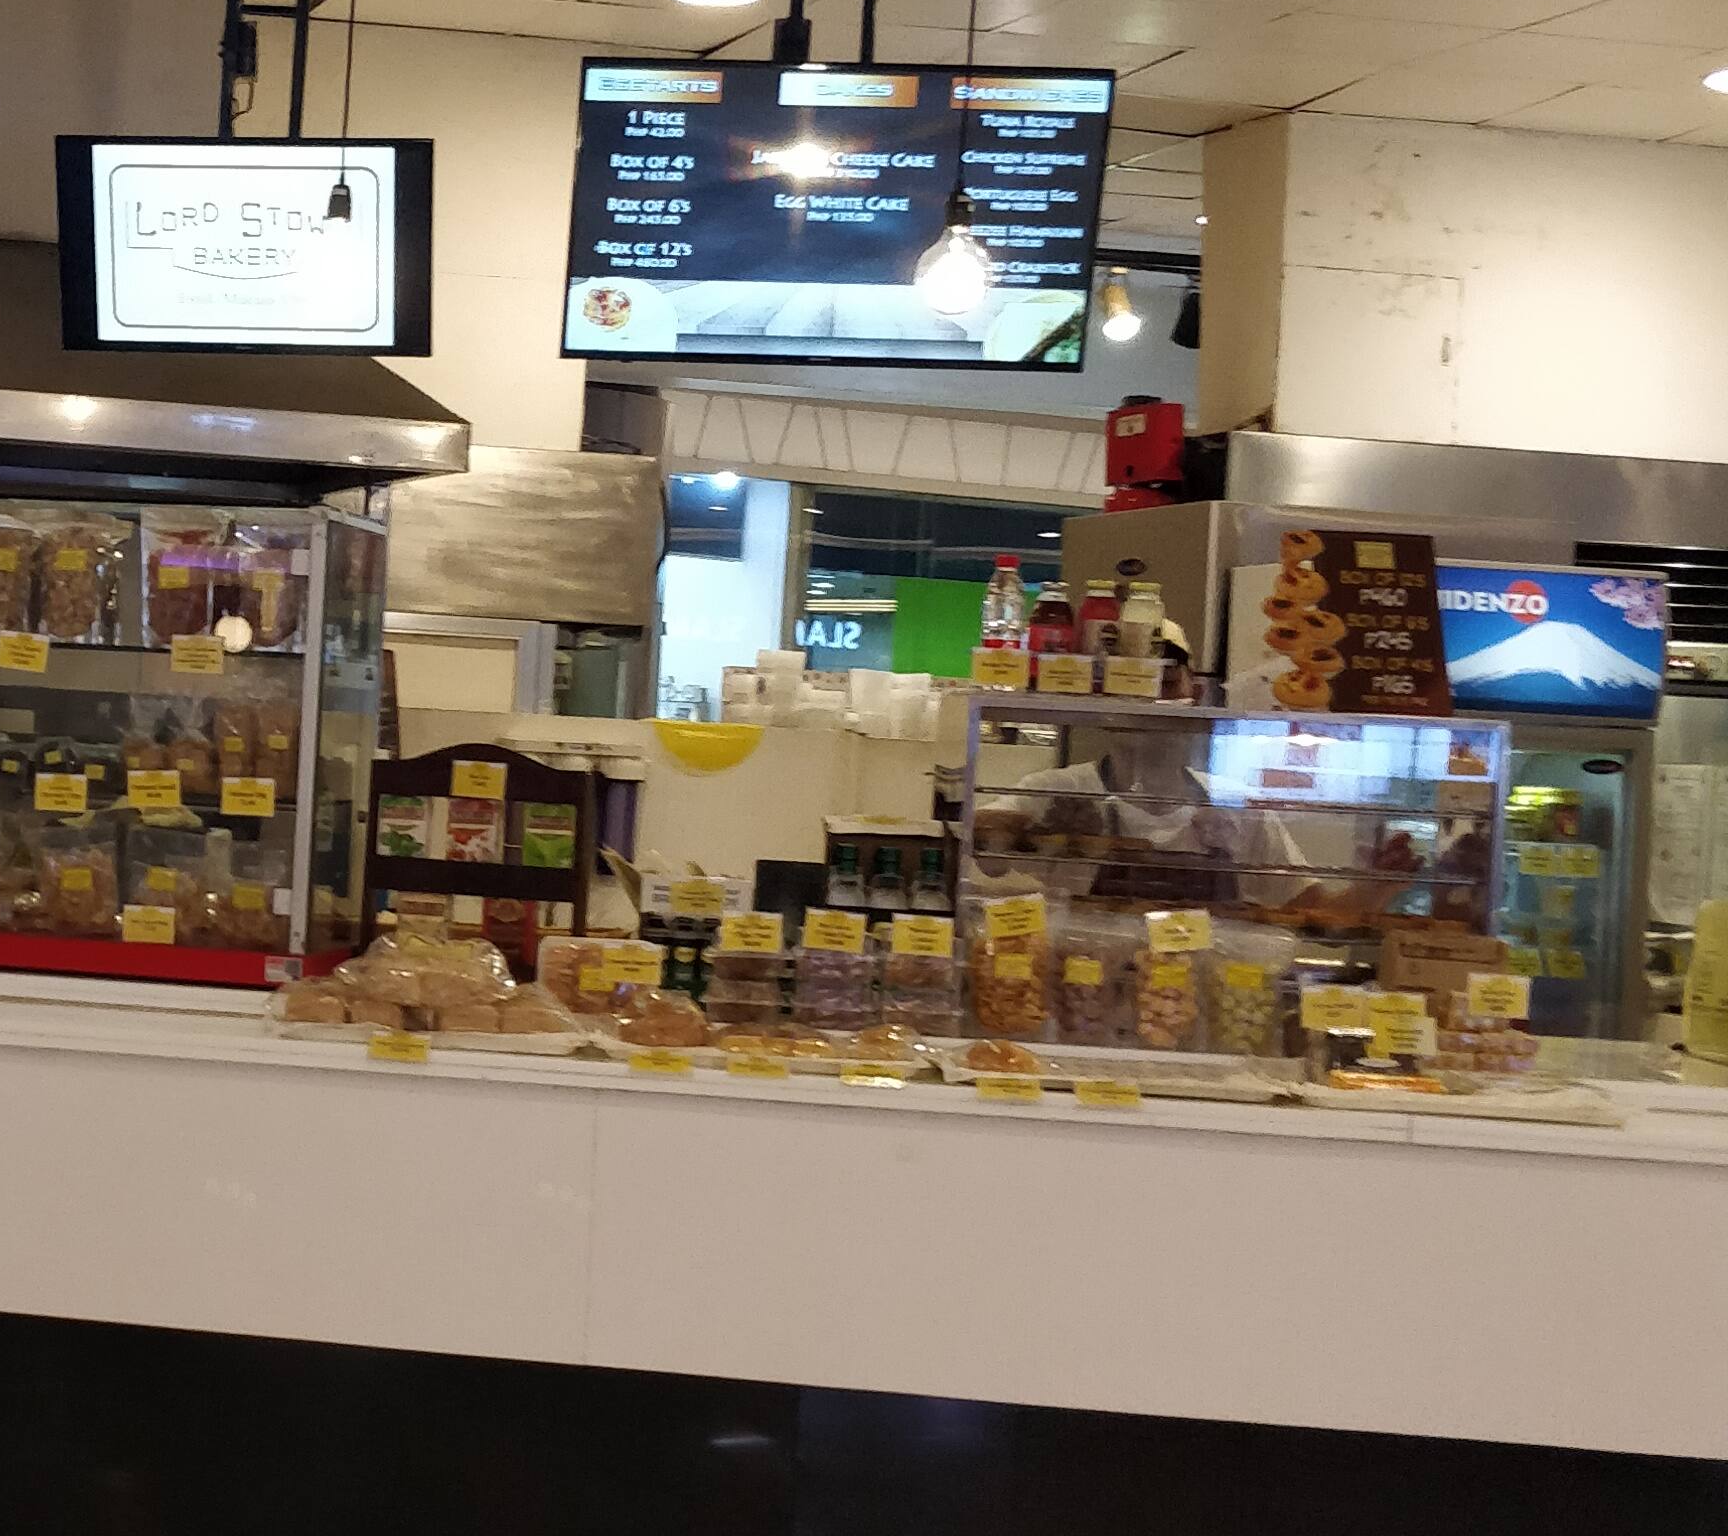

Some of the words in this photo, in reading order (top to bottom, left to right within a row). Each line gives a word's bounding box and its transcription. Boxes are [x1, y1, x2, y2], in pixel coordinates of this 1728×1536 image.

[642, 110, 685, 125] PIECE
[610, 153, 644, 168] BOX
[646, 155, 669, 168] OF
[829, 152, 890, 166] CHEESE
[891, 152, 937, 168] CAKE
[606, 197, 641, 212] BOX
[642, 199, 666, 212] OF
[774, 194, 806, 209] EGG
[808, 195, 864, 210] WHITE
[866, 196, 910, 211] CAKE
[136, 201, 219, 236] LORD
[240, 202, 329, 238] STOW
[596, 240, 632, 254] BOX
[634, 242, 656, 255] OF
[193, 247, 297, 265] BAKERY
